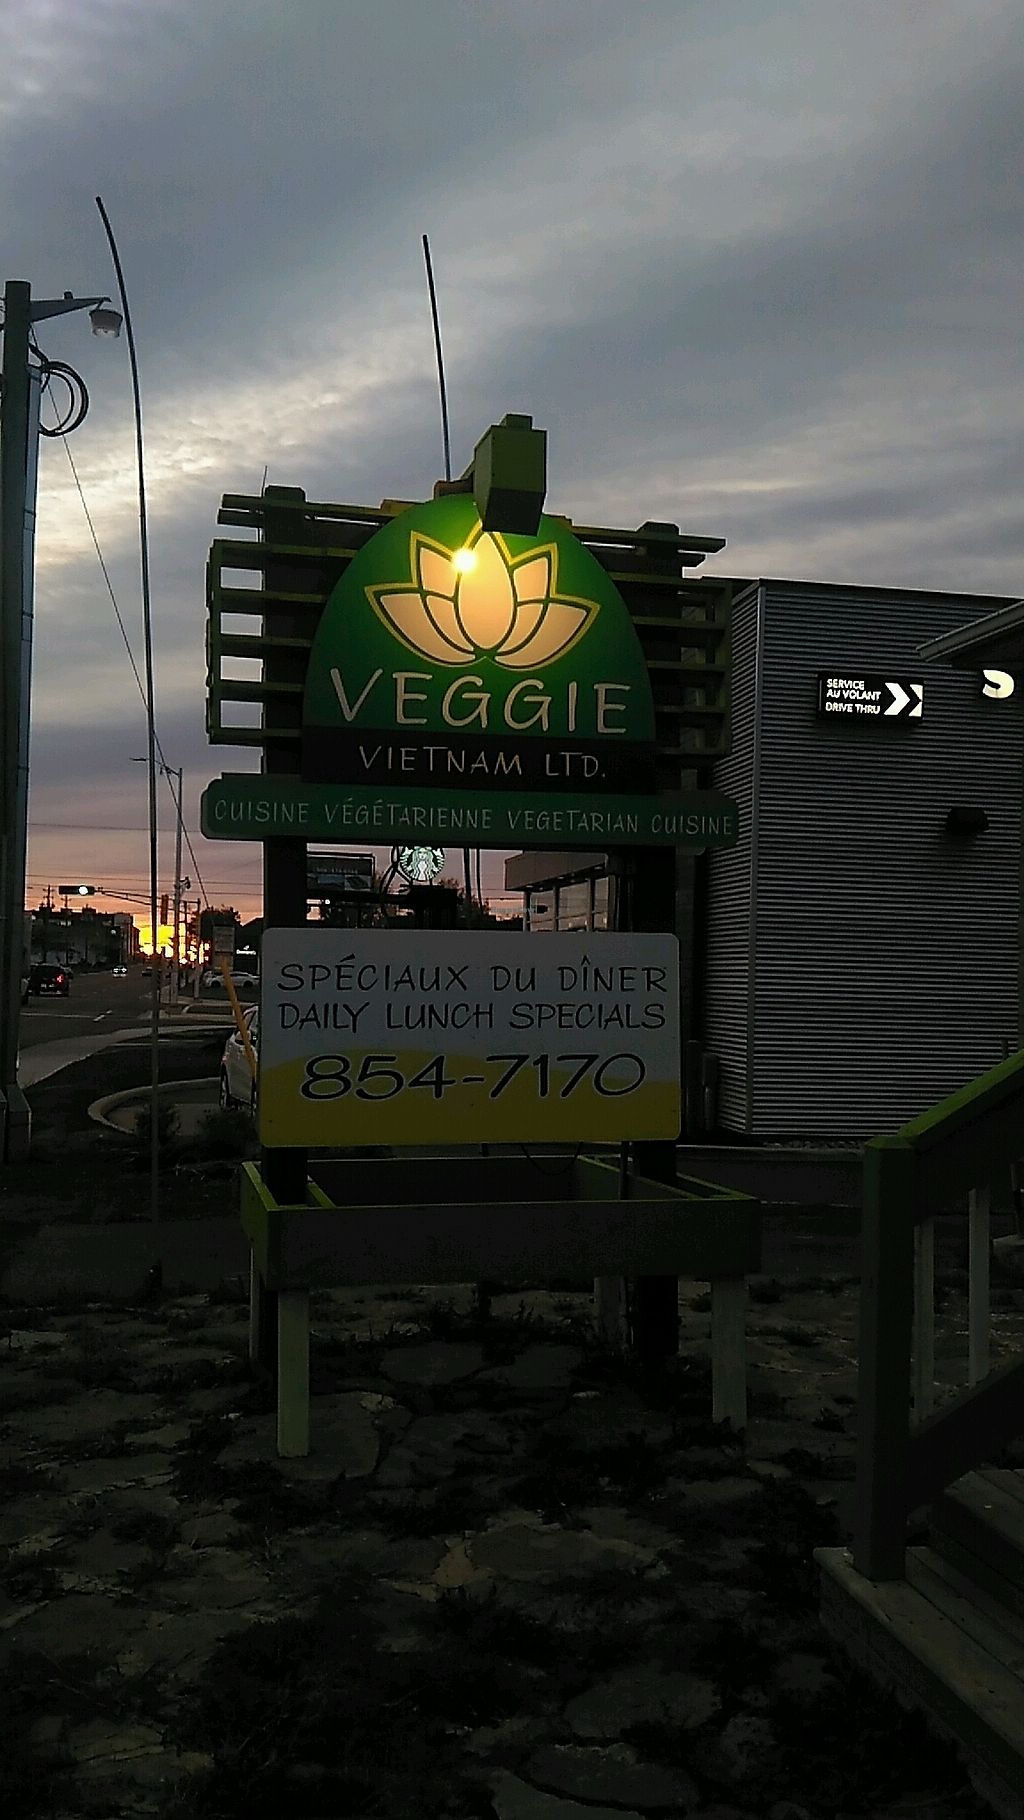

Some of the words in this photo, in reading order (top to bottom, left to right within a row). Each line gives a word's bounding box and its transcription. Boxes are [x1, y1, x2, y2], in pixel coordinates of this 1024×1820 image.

[330, 667, 631, 734] VEGGIE
[826, 678, 865, 690] SERVICE
[826, 689, 841, 698] AU
[842, 689, 882, 701] VOLANT
[825, 701, 853, 713] DRIVE
[854, 703, 881, 714] THRU
[359, 745, 523, 776] VIETNAM
[545, 752, 606, 778] LTD.
[214, 799, 310, 823] CUISINE
[324, 797, 493, 830] VÉGÉTARIENNE
[507, 809, 639, 834] VEGETARIAN
[651, 814, 733, 836] CUISINE
[277, 953, 470, 993] SPÉCIAUX
[491, 966, 536, 993] DU
[558, 954, 668, 993] DÎNER
[278, 1001, 371, 1033] DAILY
[386, 1002, 494, 1030] LUNCH
[509, 1002, 666, 1030] SPECIALS
[300, 1053, 647, 1100] 854-7170
